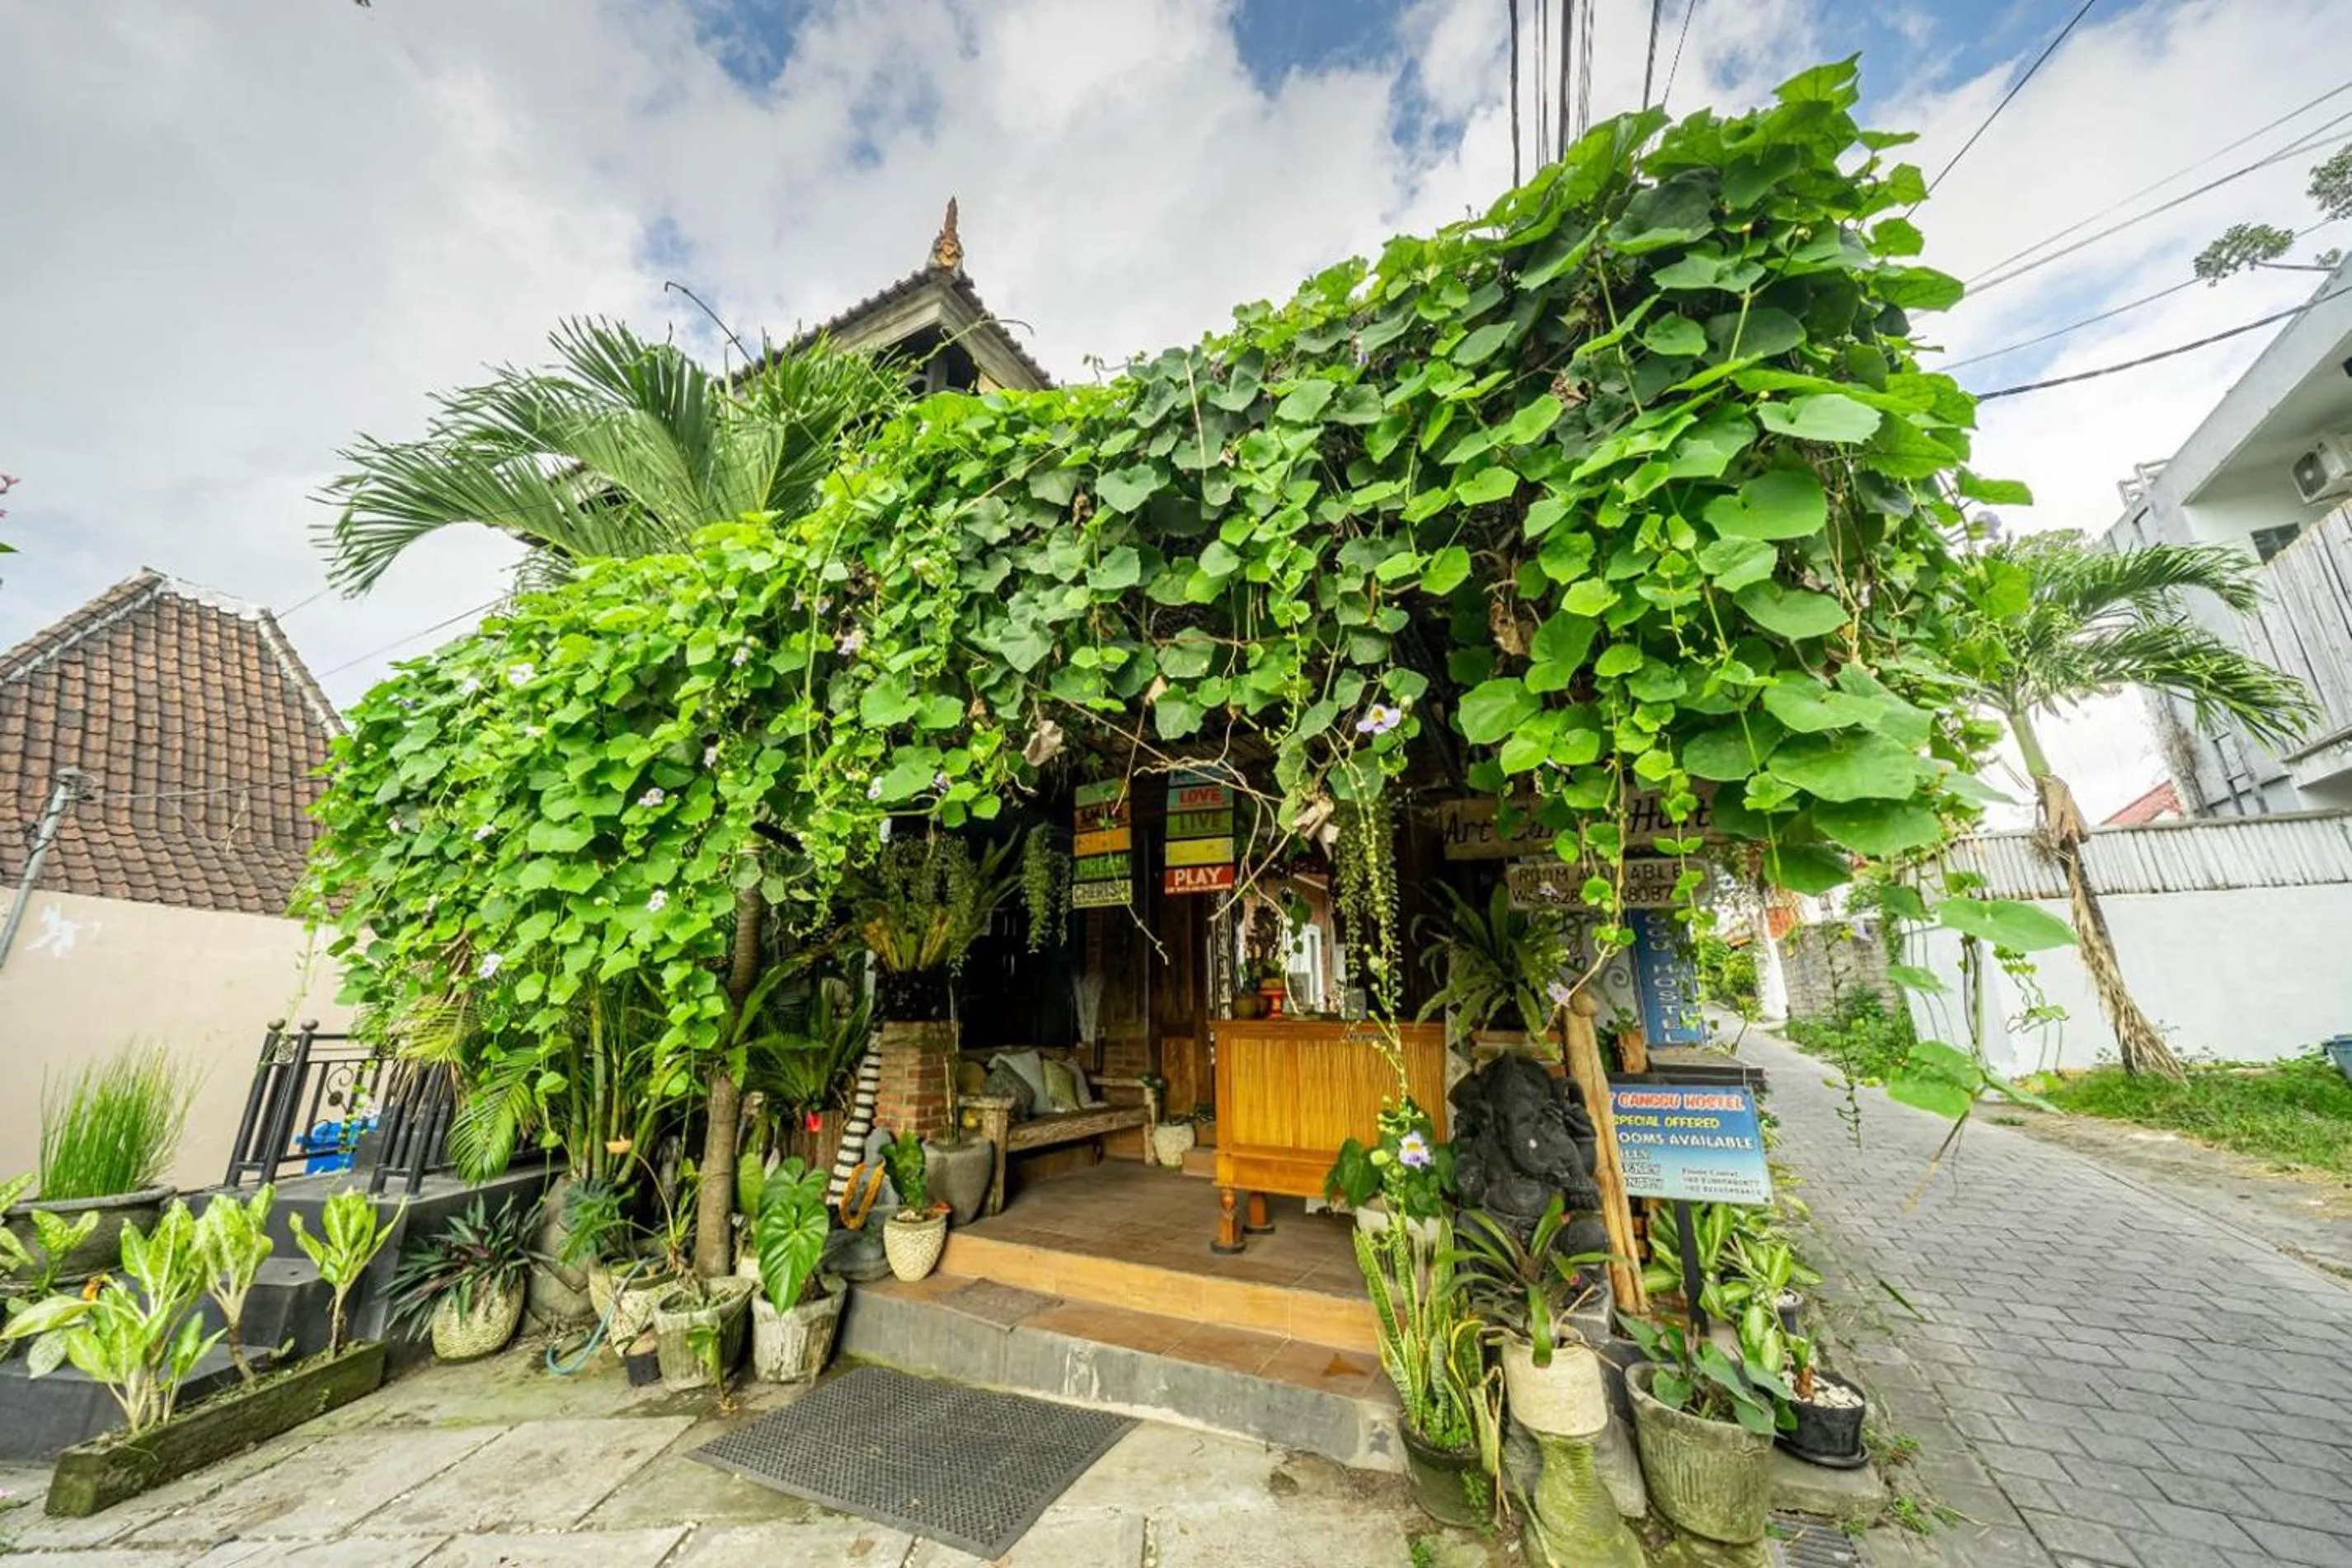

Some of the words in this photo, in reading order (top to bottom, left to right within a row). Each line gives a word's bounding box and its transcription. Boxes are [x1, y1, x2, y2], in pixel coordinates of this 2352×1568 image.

[1180, 788, 1222, 805] LOVE
[1180, 812, 1222, 830] LIVE
[1444, 810, 1492, 843] Art
[1174, 866, 1223, 887] PLAY
[1518, 867, 1570, 884] ROOM
[1683, 1093, 1746, 1111] HOSTEL
[1664, 1116, 1720, 1129] OFFERED
[1618, 1132, 1664, 1145] OOMS
[1669, 1134, 1754, 1149] AVAILABLE
